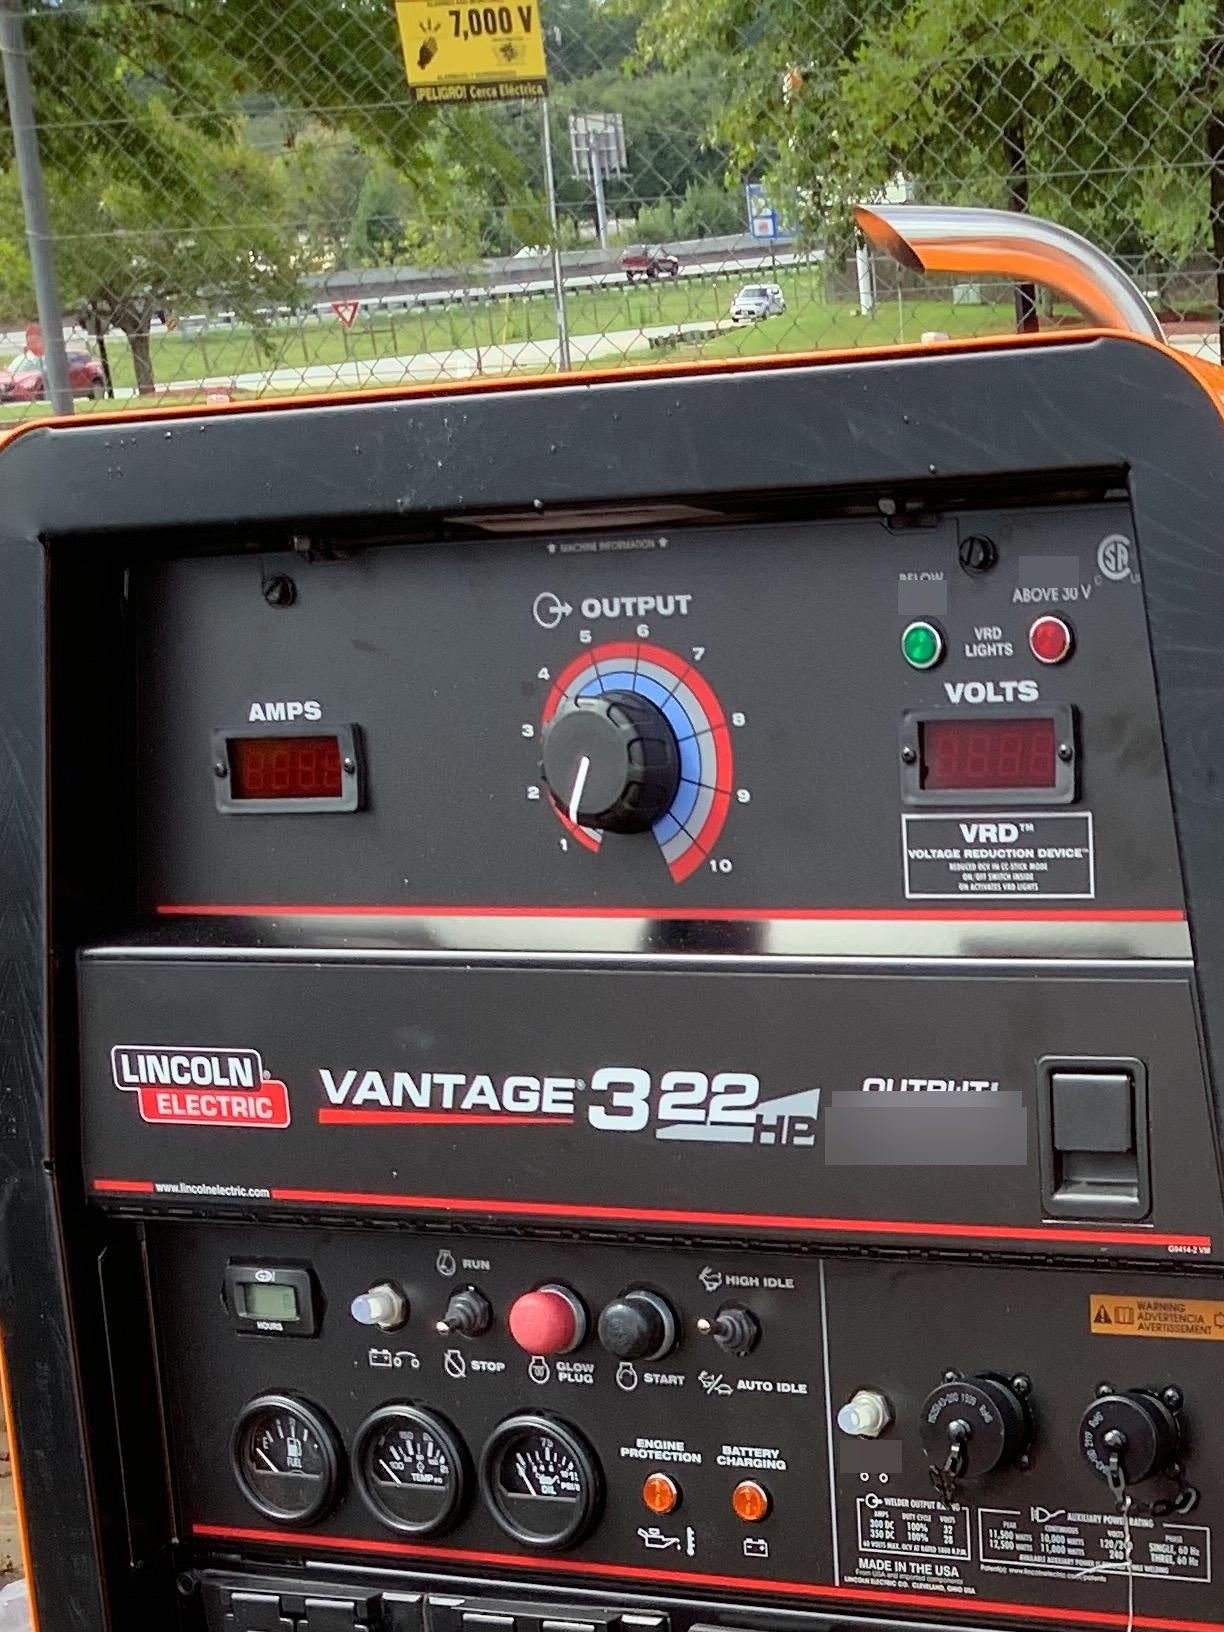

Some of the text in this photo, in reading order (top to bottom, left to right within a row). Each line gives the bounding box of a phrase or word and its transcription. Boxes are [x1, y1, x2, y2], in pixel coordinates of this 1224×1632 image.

[449, 5, 532, 41] 7,000 V
[469, 85, 498, 99] Cerca
[500, 83, 545, 97] Eléctrica
[1012, 586, 1058, 603] ABOVE
[1080, 583, 1092, 599] V
[581, 594, 692, 619] OUTPUT
[580, 629, 592, 643] 5
[636, 624, 650, 638] 6
[974, 627, 1001, 640] VRD
[693, 647, 706, 661] 7
[965, 643, 1013, 657] LIGHTS
[537, 667, 550, 681] 4
[944, 680, 1040, 703] VOLTS
[248, 701, 323, 722] AMPS
[733, 713, 746, 727] 8
[521, 724, 535, 738] 3
[527, 786, 540, 801] 2
[736, 788, 751, 804] 9
[559, 838, 568, 851] 1
[908, 849, 960, 859] VOLTAGE
[964, 848, 1034, 859] REDUCTION
[709, 859, 733, 874] 10
[121, 1053, 254, 1087] LINCOLN
[588, 1066, 761, 1132] 322
[157, 1093, 273, 1120] ELECTRIC
[155, 1182, 270, 1198] www.lincolnelectric.com
[462, 1259, 490, 1271] RUN
[725, 1275, 795, 1289] HIGH IDLE
[1137, 1301, 1186, 1313] WARNING
[1137, 1312, 1206, 1324] ADVERTENCIA
[1137, 1322, 1212, 1335] AVERTISSEMENT
[471, 1360, 505, 1372] STOP
[556, 1361, 594, 1374] GLOW
[558, 1372, 594, 1384] PLUG
[643, 1373, 685, 1386] START
[737, 1380, 807, 1394] AUTO IDLE
[636, 1438, 685, 1451] ENGINE
[620, 1448, 702, 1464] PROTECTION
[722, 1445, 780, 1459] BATTERY
[716, 1454, 787, 1470] CHARGING
[884, 1498, 935, 1510] WELDER OUTPUT
[1067, 1512, 1102, 1523] AUXILIARY
[859, 1558, 959, 1577] MADE IN THE USA
